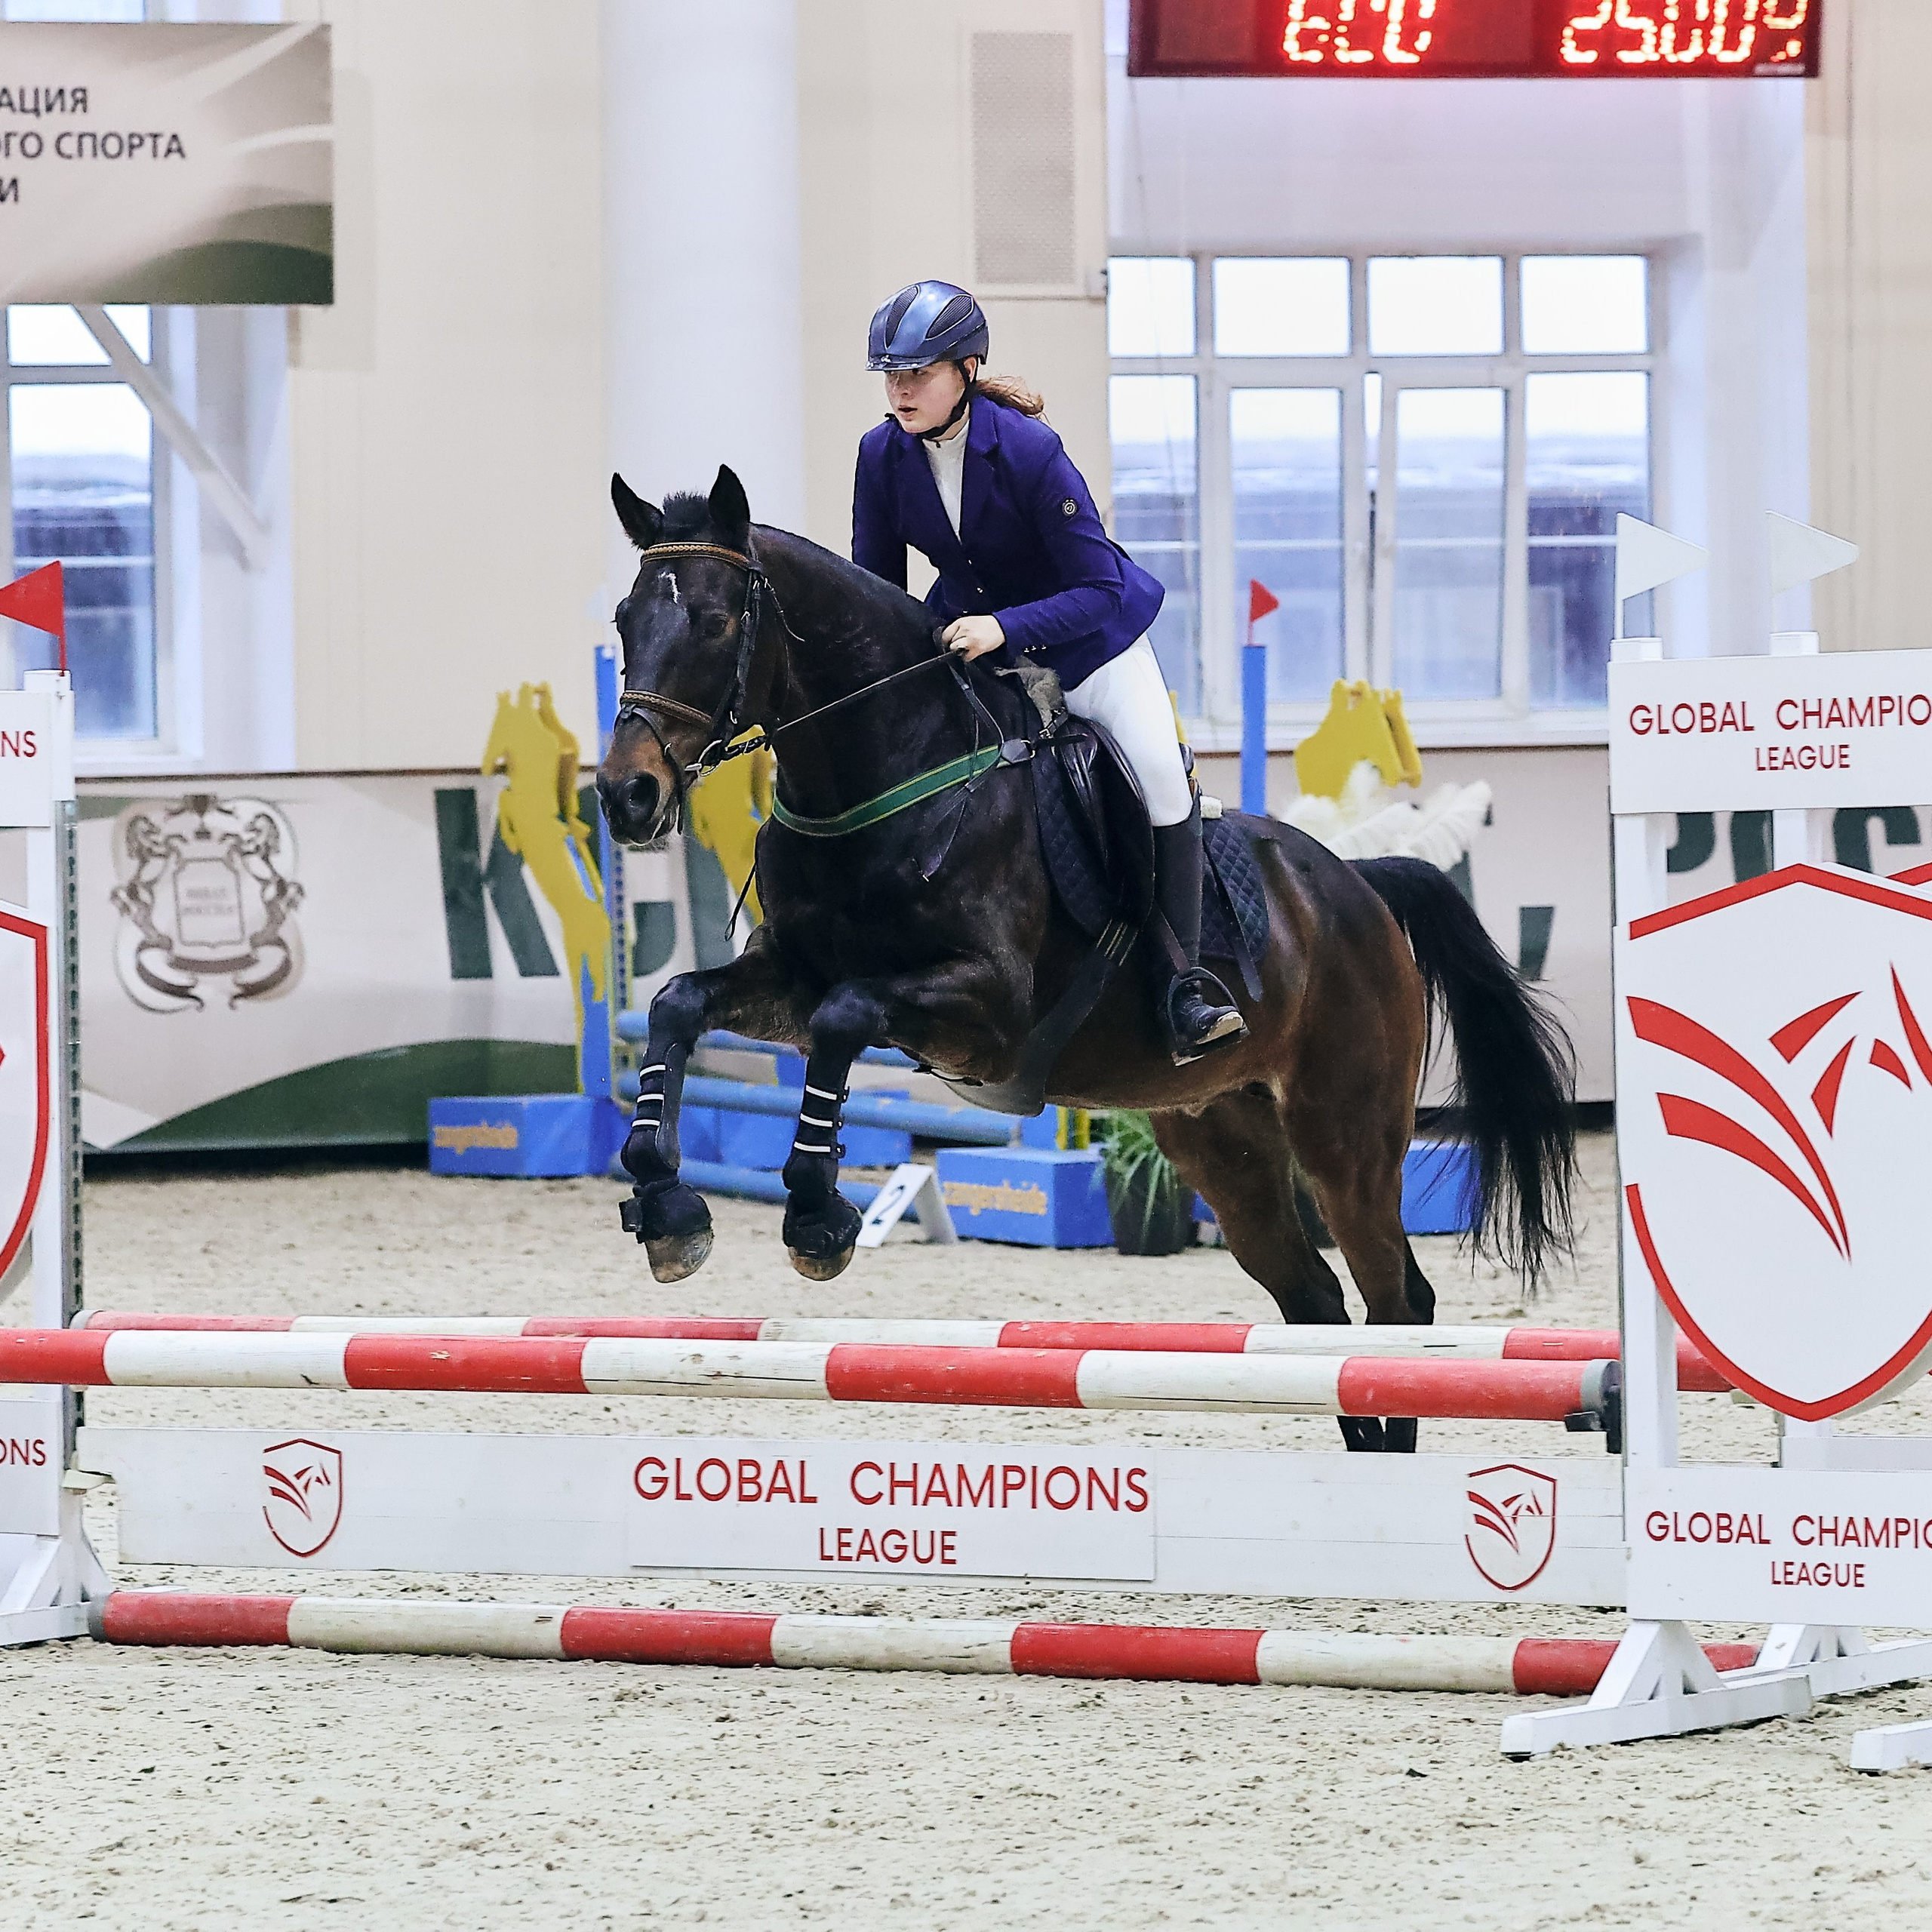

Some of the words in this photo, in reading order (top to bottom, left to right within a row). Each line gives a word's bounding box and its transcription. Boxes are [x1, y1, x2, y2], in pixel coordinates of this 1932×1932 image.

[0, 87, 88, 119] АЦИЯ
[0, 131, 44, 159] ГО
[55, 131, 186, 159] СПОРТА
[1629, 702, 1755, 735] GLOBAL
[1776, 694, 1932, 731] CHAMPIO
[1, 731, 37, 758] NS
[1755, 744, 1850, 771] LEAGUE
[0, 1438, 47, 1466] NS
[633, 1457, 818, 1504] GLOBAL
[850, 1460, 1149, 1512] CHAMPIONS
[1646, 1510, 1772, 1545] GLOBAL
[819, 1527, 957, 1565] LEAGUE
[1770, 1561, 1866, 1588] LEAGUE
